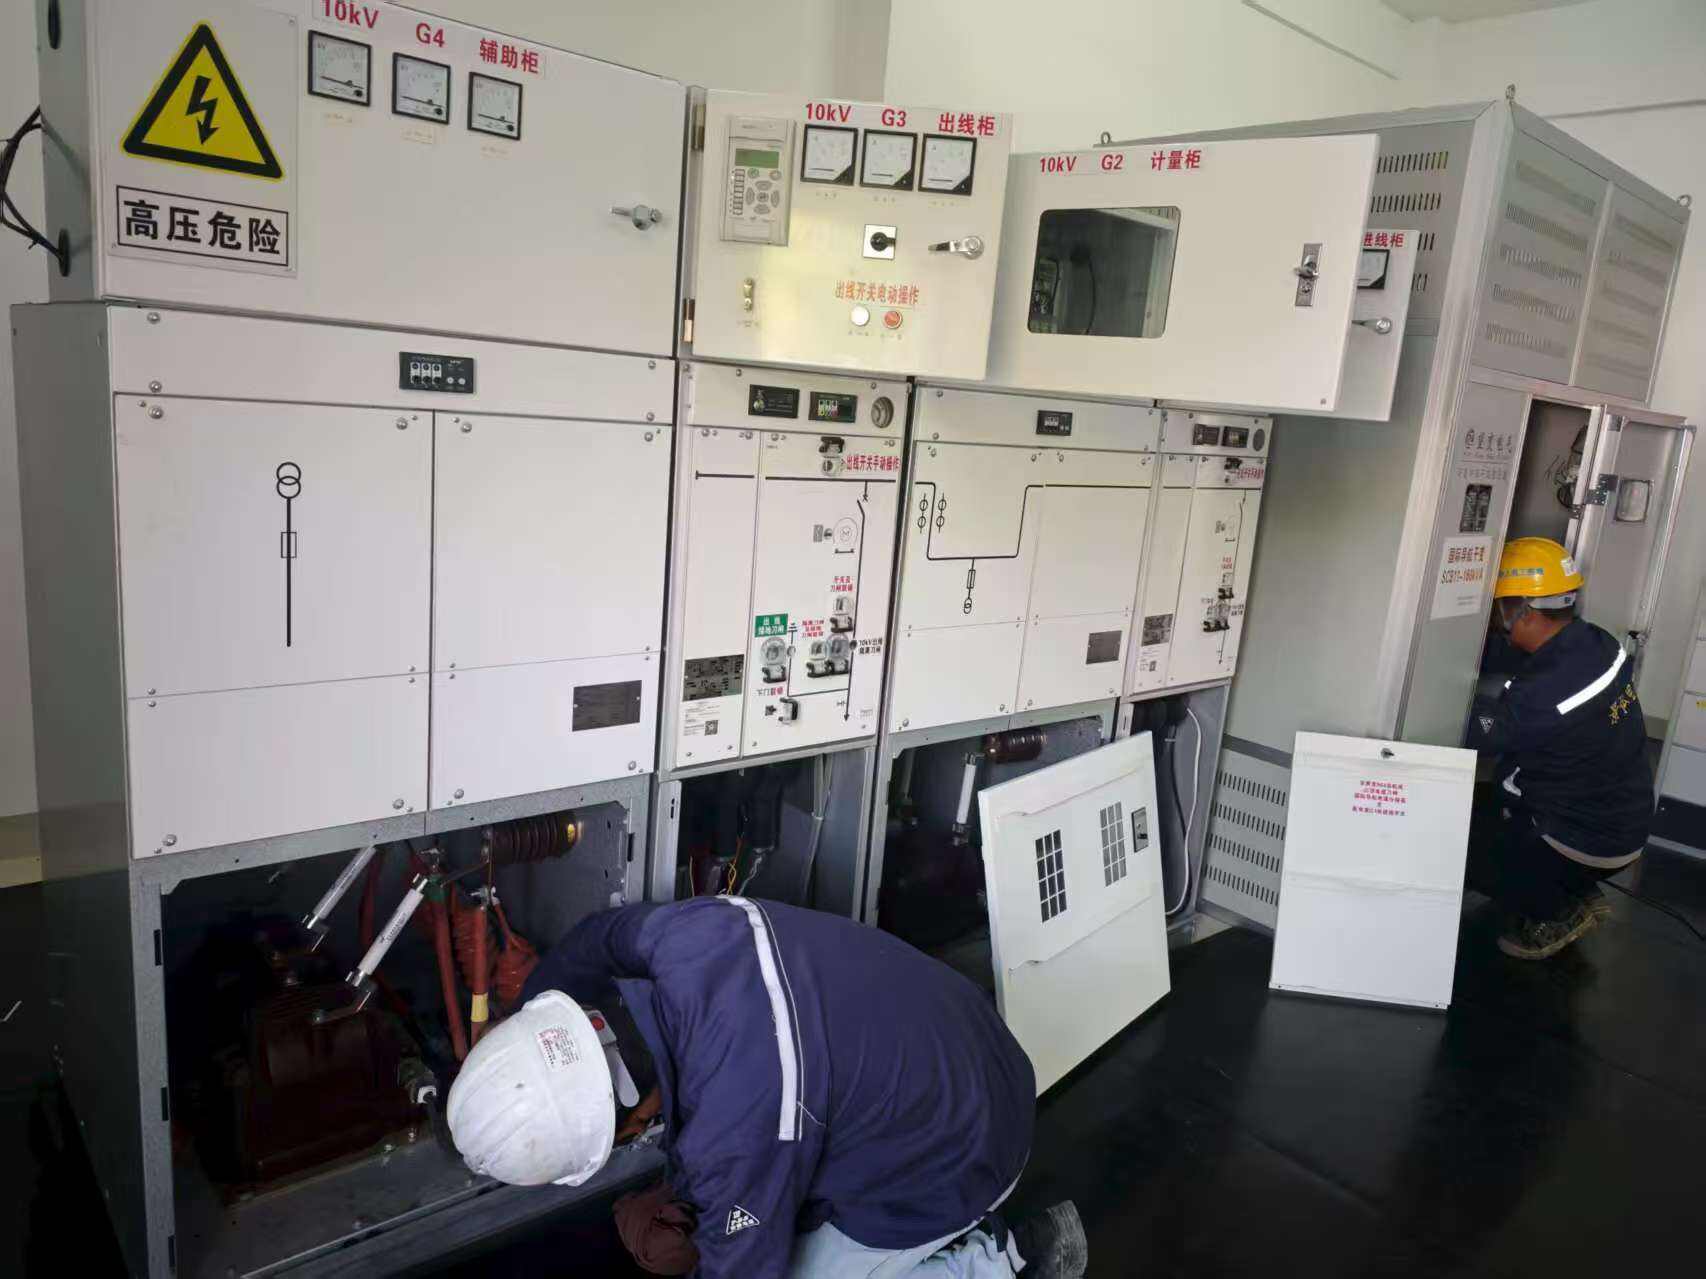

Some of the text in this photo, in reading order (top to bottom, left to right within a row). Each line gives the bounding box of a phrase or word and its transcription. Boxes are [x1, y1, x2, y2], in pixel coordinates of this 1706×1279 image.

[321, 0, 539, 74] 10kV G4 辅助柜
[805, 103, 996, 137] 10kV G3 出线柜
[1039, 148, 1202, 173] 10kV G2 计量柜
[122, 198, 281, 256] 高压危险
